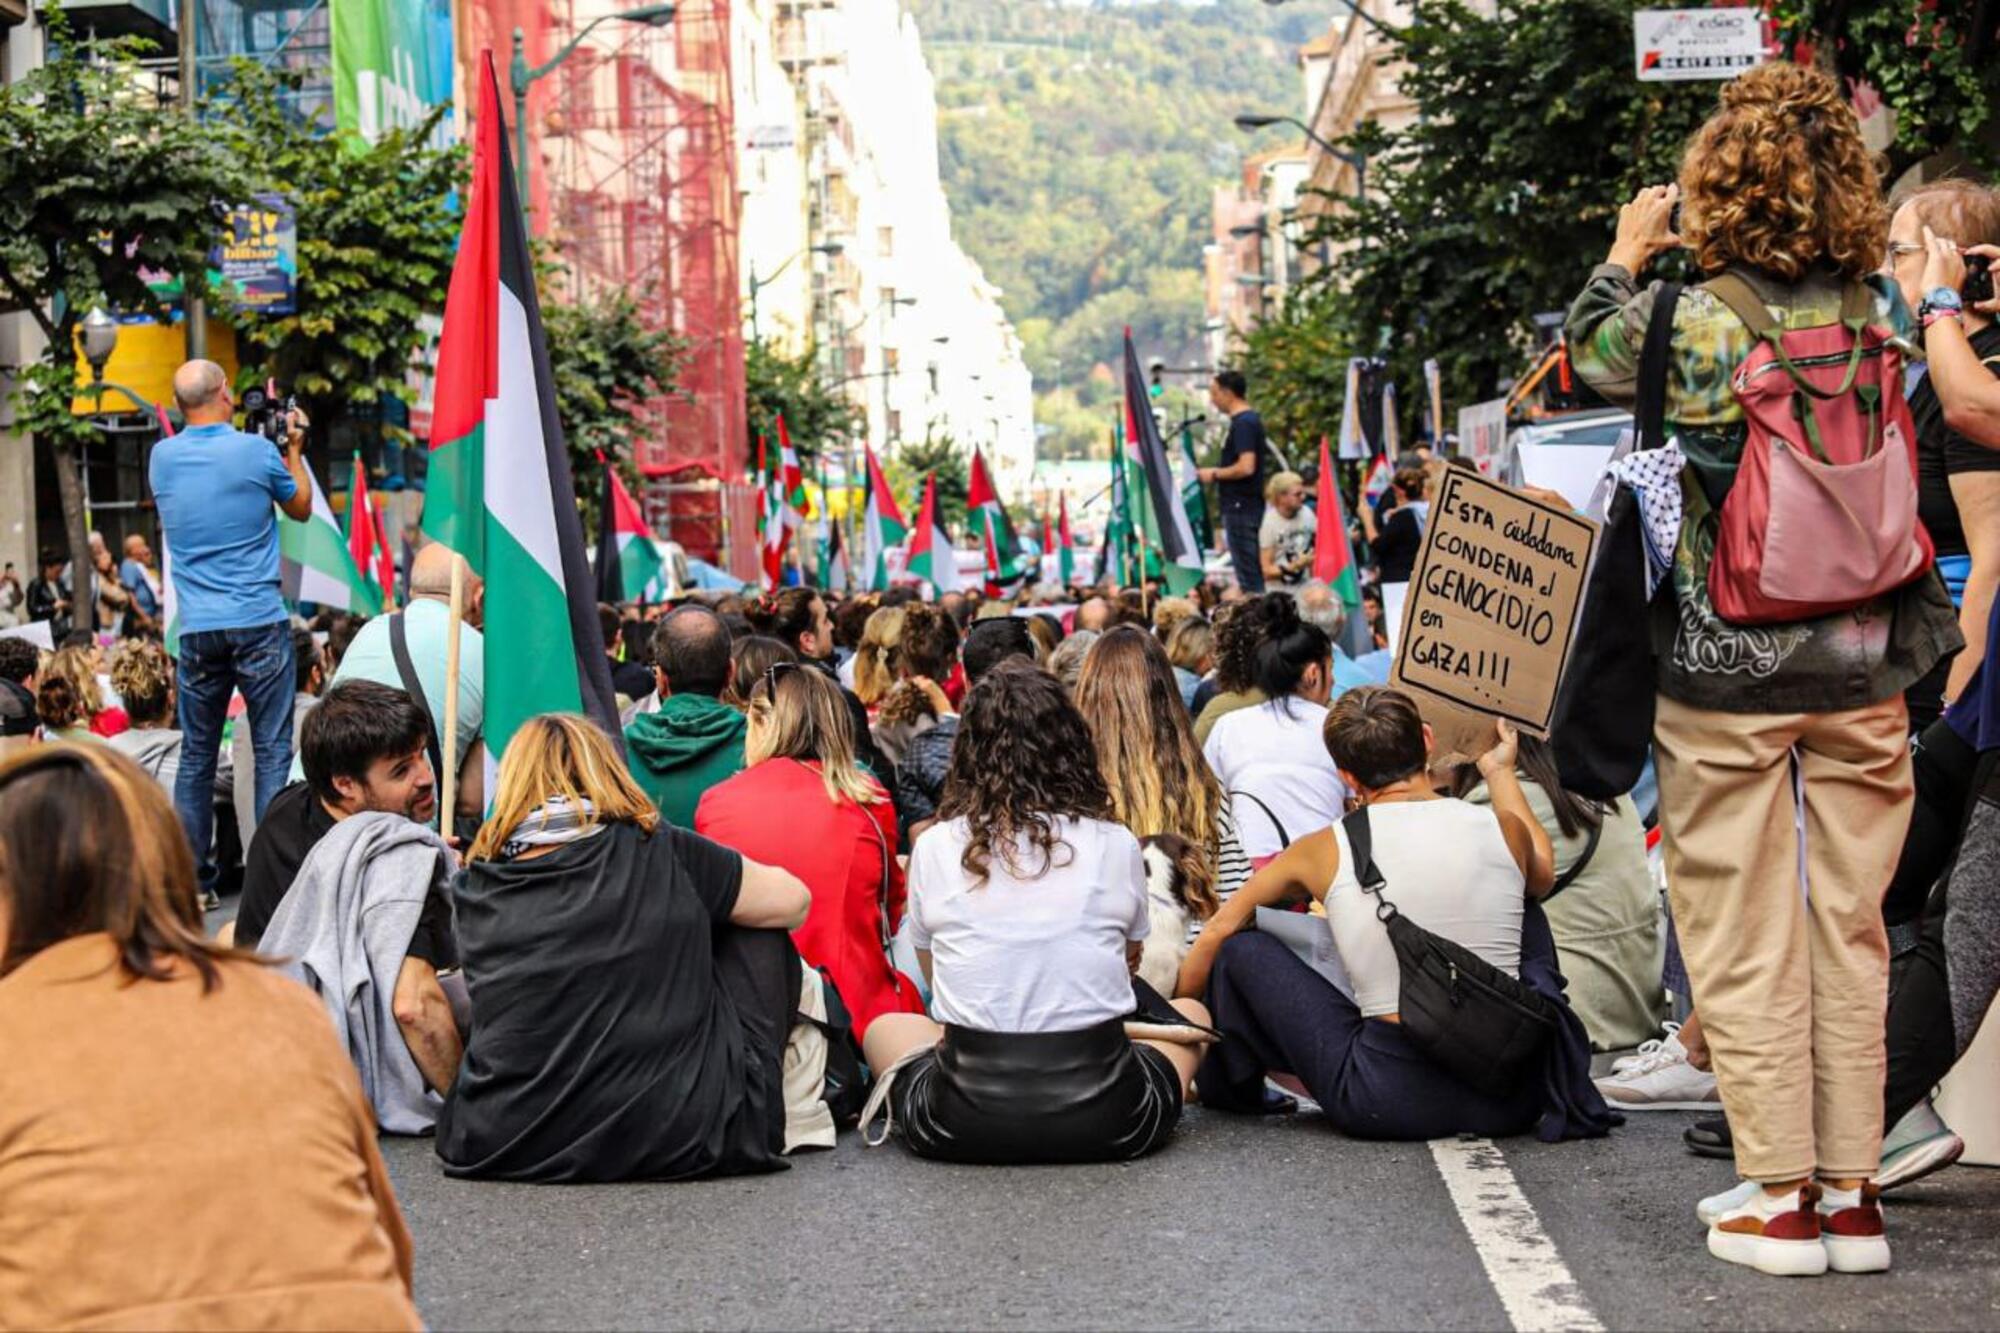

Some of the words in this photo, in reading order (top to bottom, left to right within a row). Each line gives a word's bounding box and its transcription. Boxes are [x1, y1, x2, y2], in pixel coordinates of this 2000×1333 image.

[1435, 531, 1533, 588] CONDENA
[1539, 572, 1557, 597] el
[1503, 512, 1577, 568] ciudadana
[1420, 609, 1443, 629] en
[1411, 635, 1510, 705] GAZA!!!
